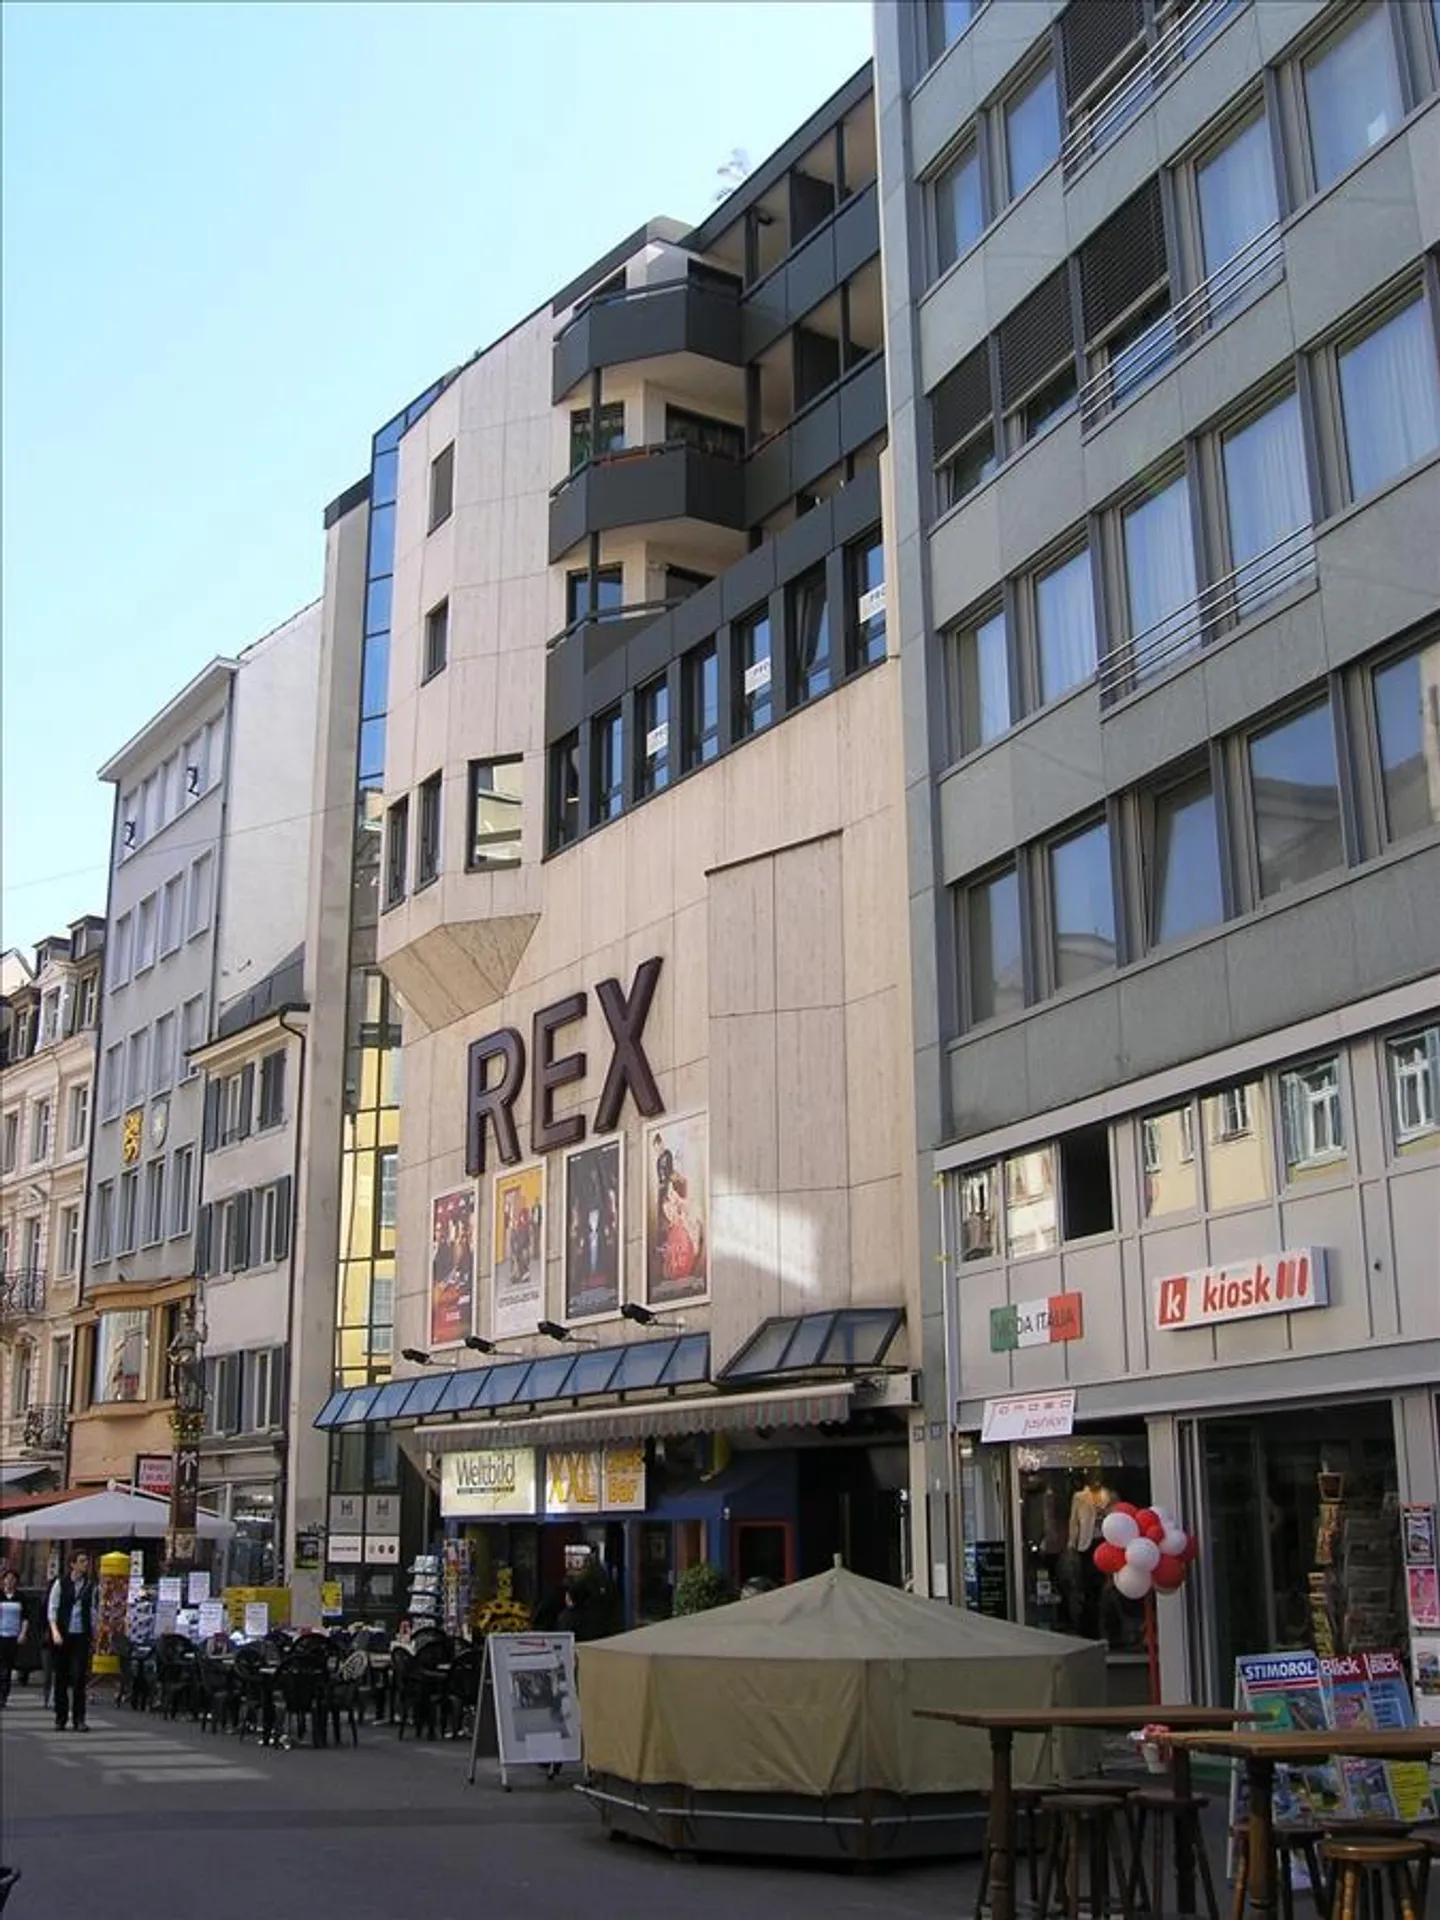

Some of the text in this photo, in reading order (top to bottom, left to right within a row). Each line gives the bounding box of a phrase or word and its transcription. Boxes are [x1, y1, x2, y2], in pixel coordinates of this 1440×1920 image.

[466, 955, 666, 1177] REX
[1203, 1263, 1271, 1312] kiosk
[1037, 1307, 1075, 1331] ITALIA
[456, 1454, 515, 1486] Weltbild
[1244, 1661, 1316, 1680] STIMOROL
[1320, 1657, 1360, 1676] Blick
[1370, 1657, 1399, 1674] Blick
